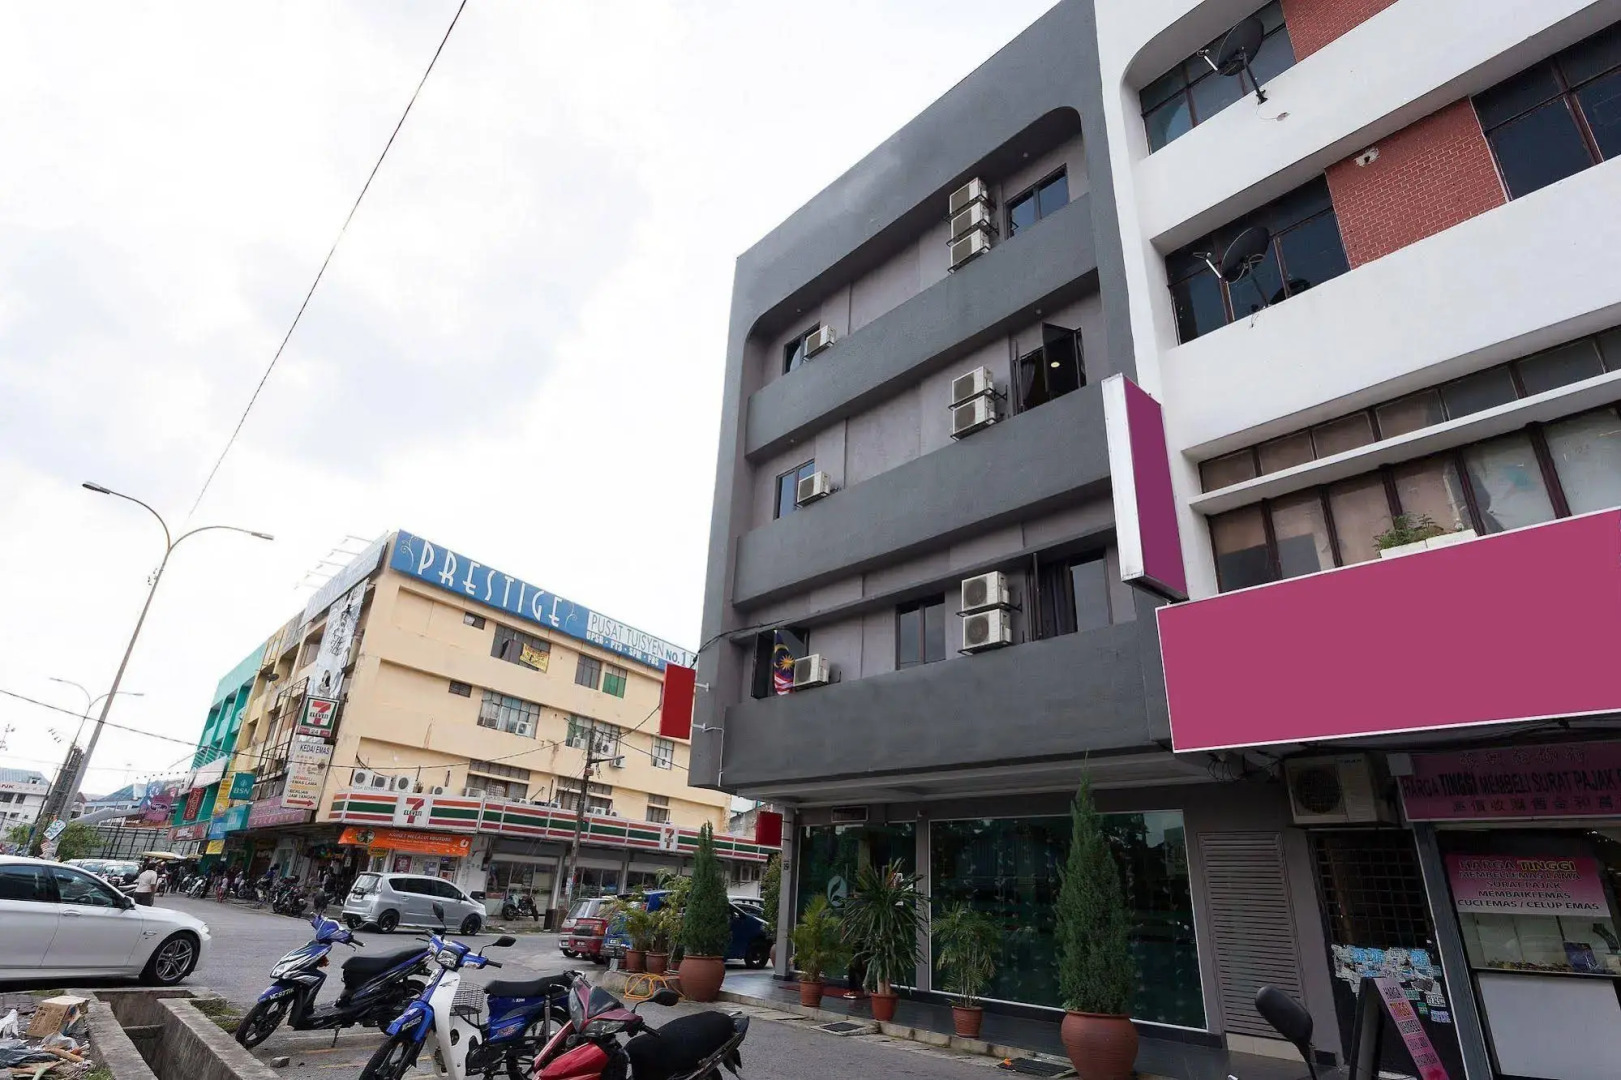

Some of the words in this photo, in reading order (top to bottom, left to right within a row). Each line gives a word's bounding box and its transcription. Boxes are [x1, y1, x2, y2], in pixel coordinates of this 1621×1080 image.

[417, 540, 563, 627] PRESTIGE
[591, 614, 623, 641] PUSAT
[627, 629, 665, 657] TUISYEN
[312, 701, 332, 726] 7
[300, 744, 315, 753] KEDAI
[315, 745, 330, 755] EMAS
[1531, 771, 1572, 793] SURAT
[1573, 768, 1615, 791] PAJAK
[406, 797, 425, 824] 7
[665, 827, 674, 848] 7
[1458, 859, 1515, 871] HARGA
[1516, 860, 1577, 872] TINGGI
[1457, 899, 1483, 907] CUCI
[1484, 900, 1517, 908] EMAS
[1526, 901, 1563, 909] CELUP
[1565, 902, 1600, 910] EMAS
[1477, 890, 1535, 898] MEMBAIKI
[1537, 891, 1571, 899] EMAS
